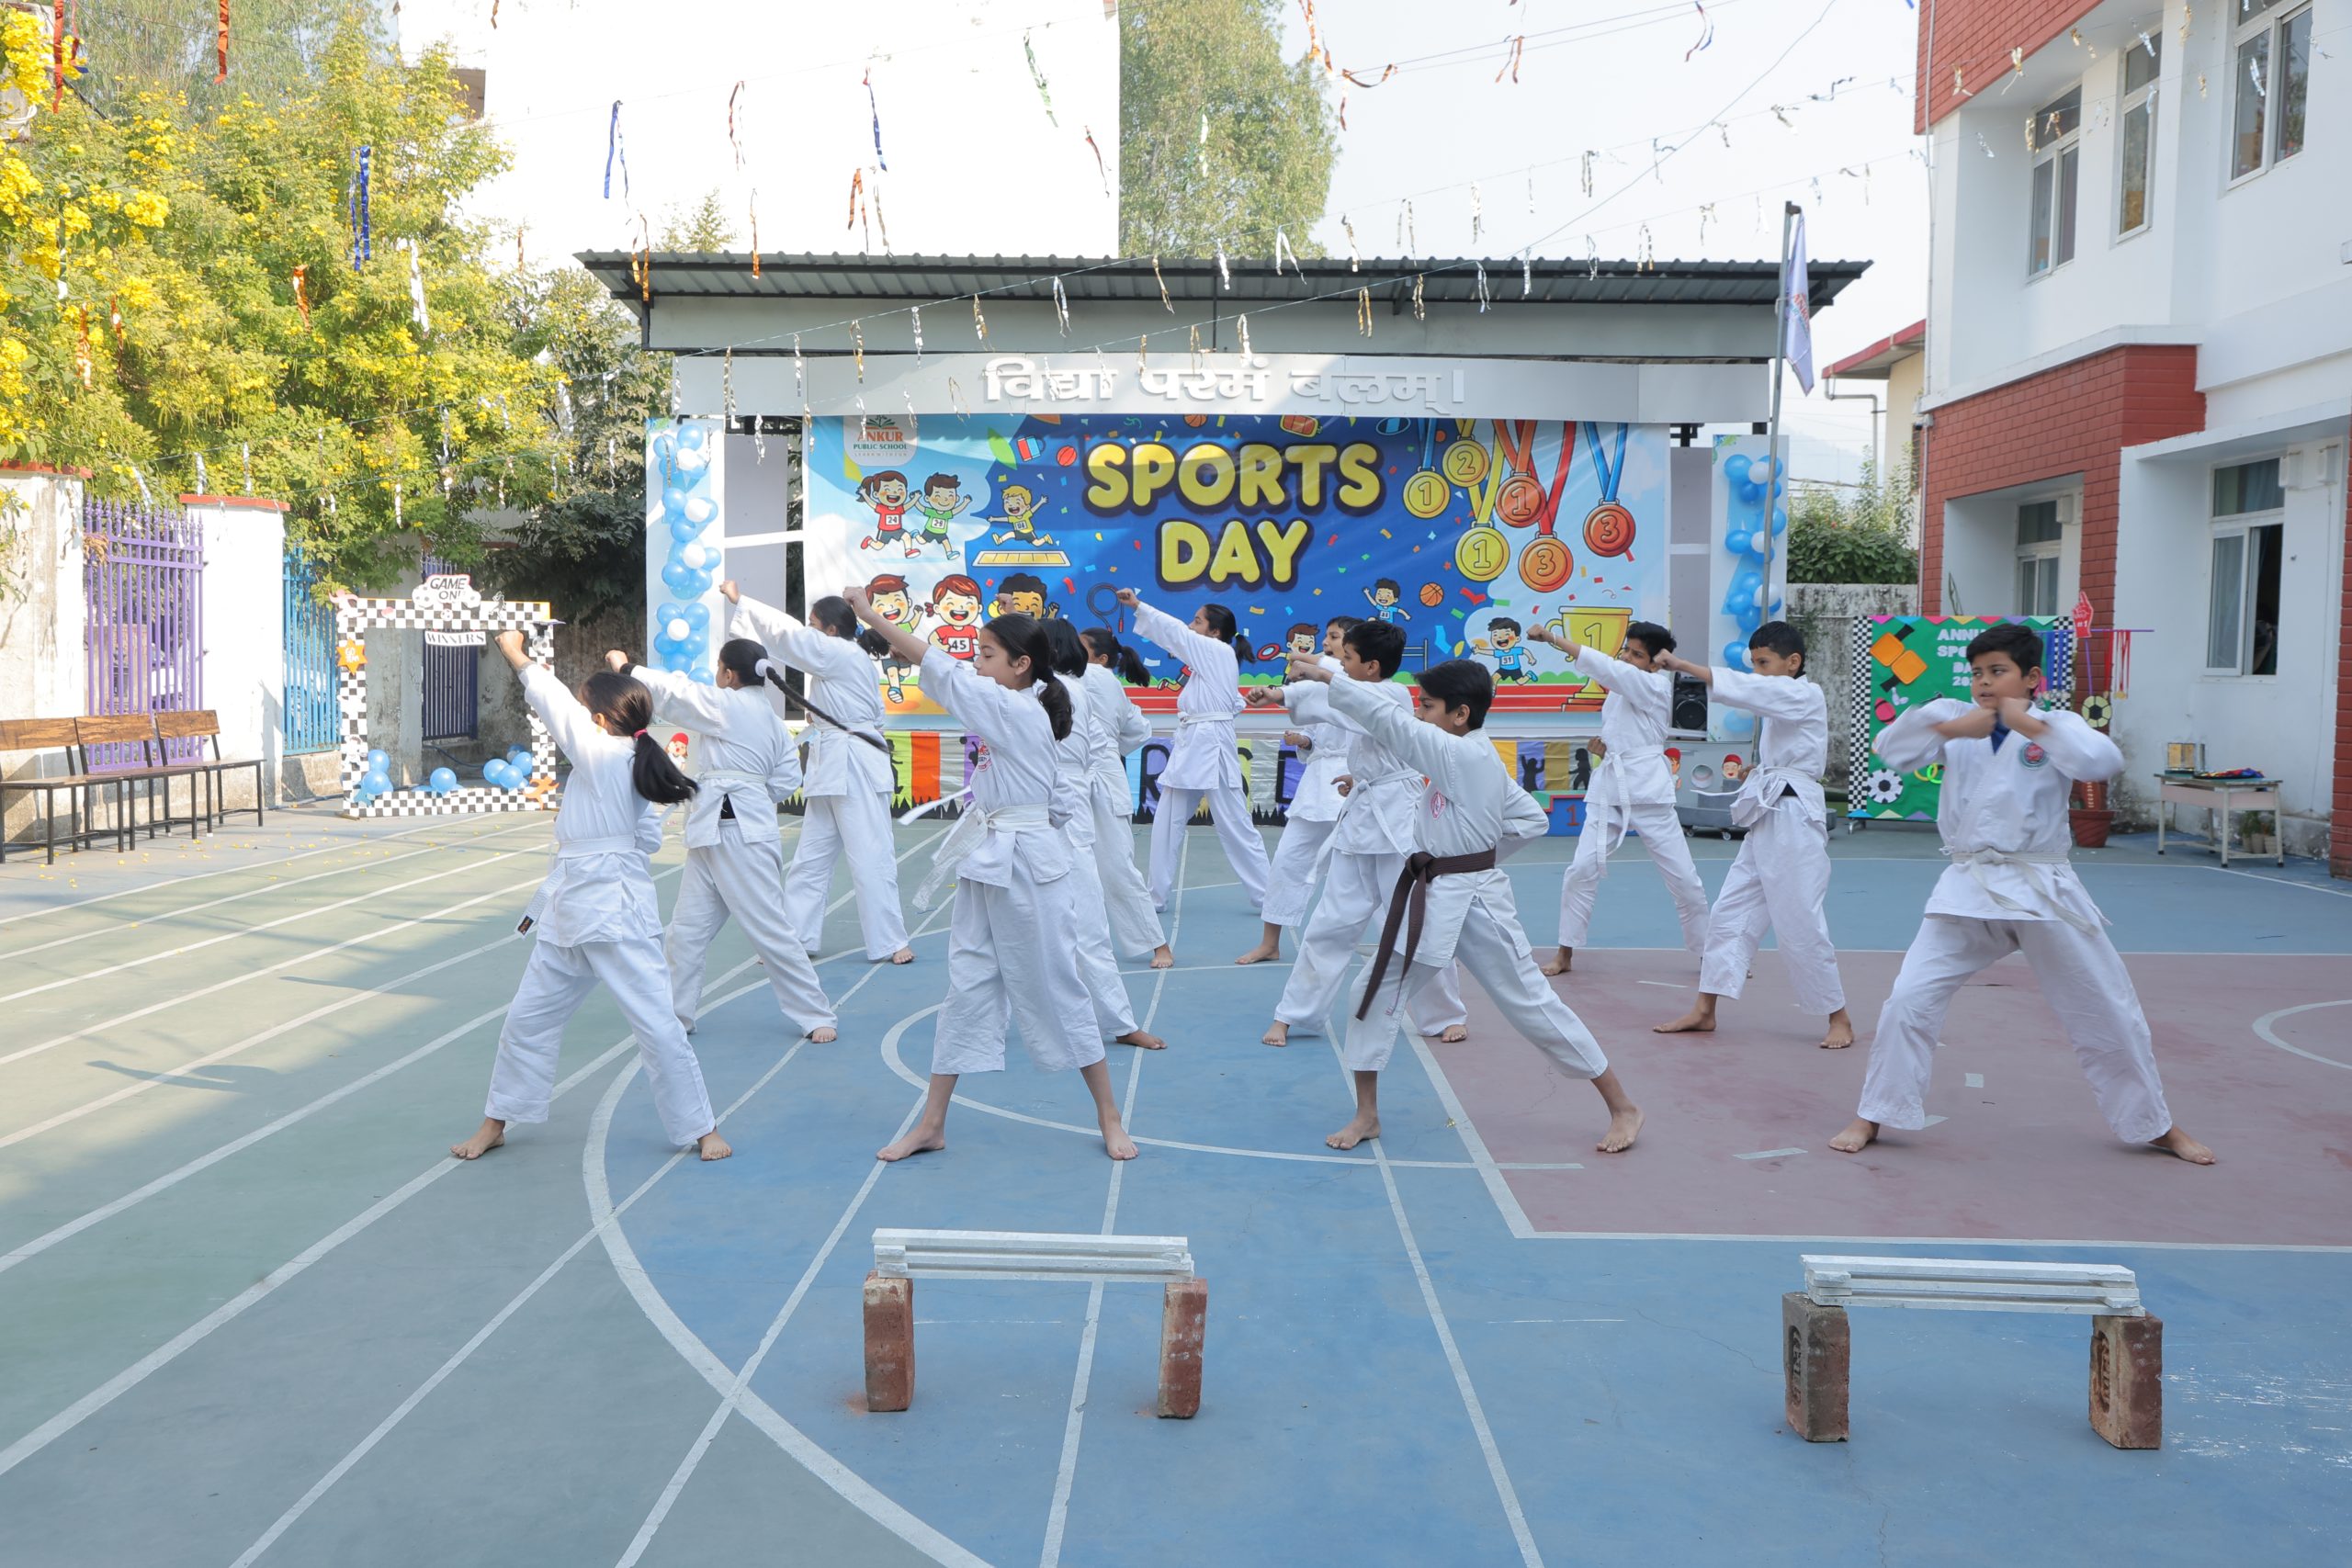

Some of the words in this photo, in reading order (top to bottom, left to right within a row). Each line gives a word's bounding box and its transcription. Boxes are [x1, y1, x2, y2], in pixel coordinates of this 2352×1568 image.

[857, 431, 904, 442] ANKUR
[1455, 450, 1476, 476] 2
[1086, 442, 1383, 510] SPORTS
[1418, 480, 1432, 506] 1
[1510, 486, 1532, 517] 1
[1600, 514, 1622, 544] 3
[1159, 519, 1308, 583] DAY
[1473, 538, 1492, 569] 1
[1536, 547, 1555, 577] 3
[430, 577, 467, 590] GAME
[426, 632, 485, 644] WINNERS
[951, 639, 967, 650] 45
[1584, 622, 1602, 651] 1
[1937, 628, 1986, 641] ANN
[345, 647, 356, 655] GO
[1937, 645, 1967, 658] SPO
[1952, 661, 1973, 674] DA
[1952, 675, 1971, 687] 20
[1566, 804, 1580, 827] 1
